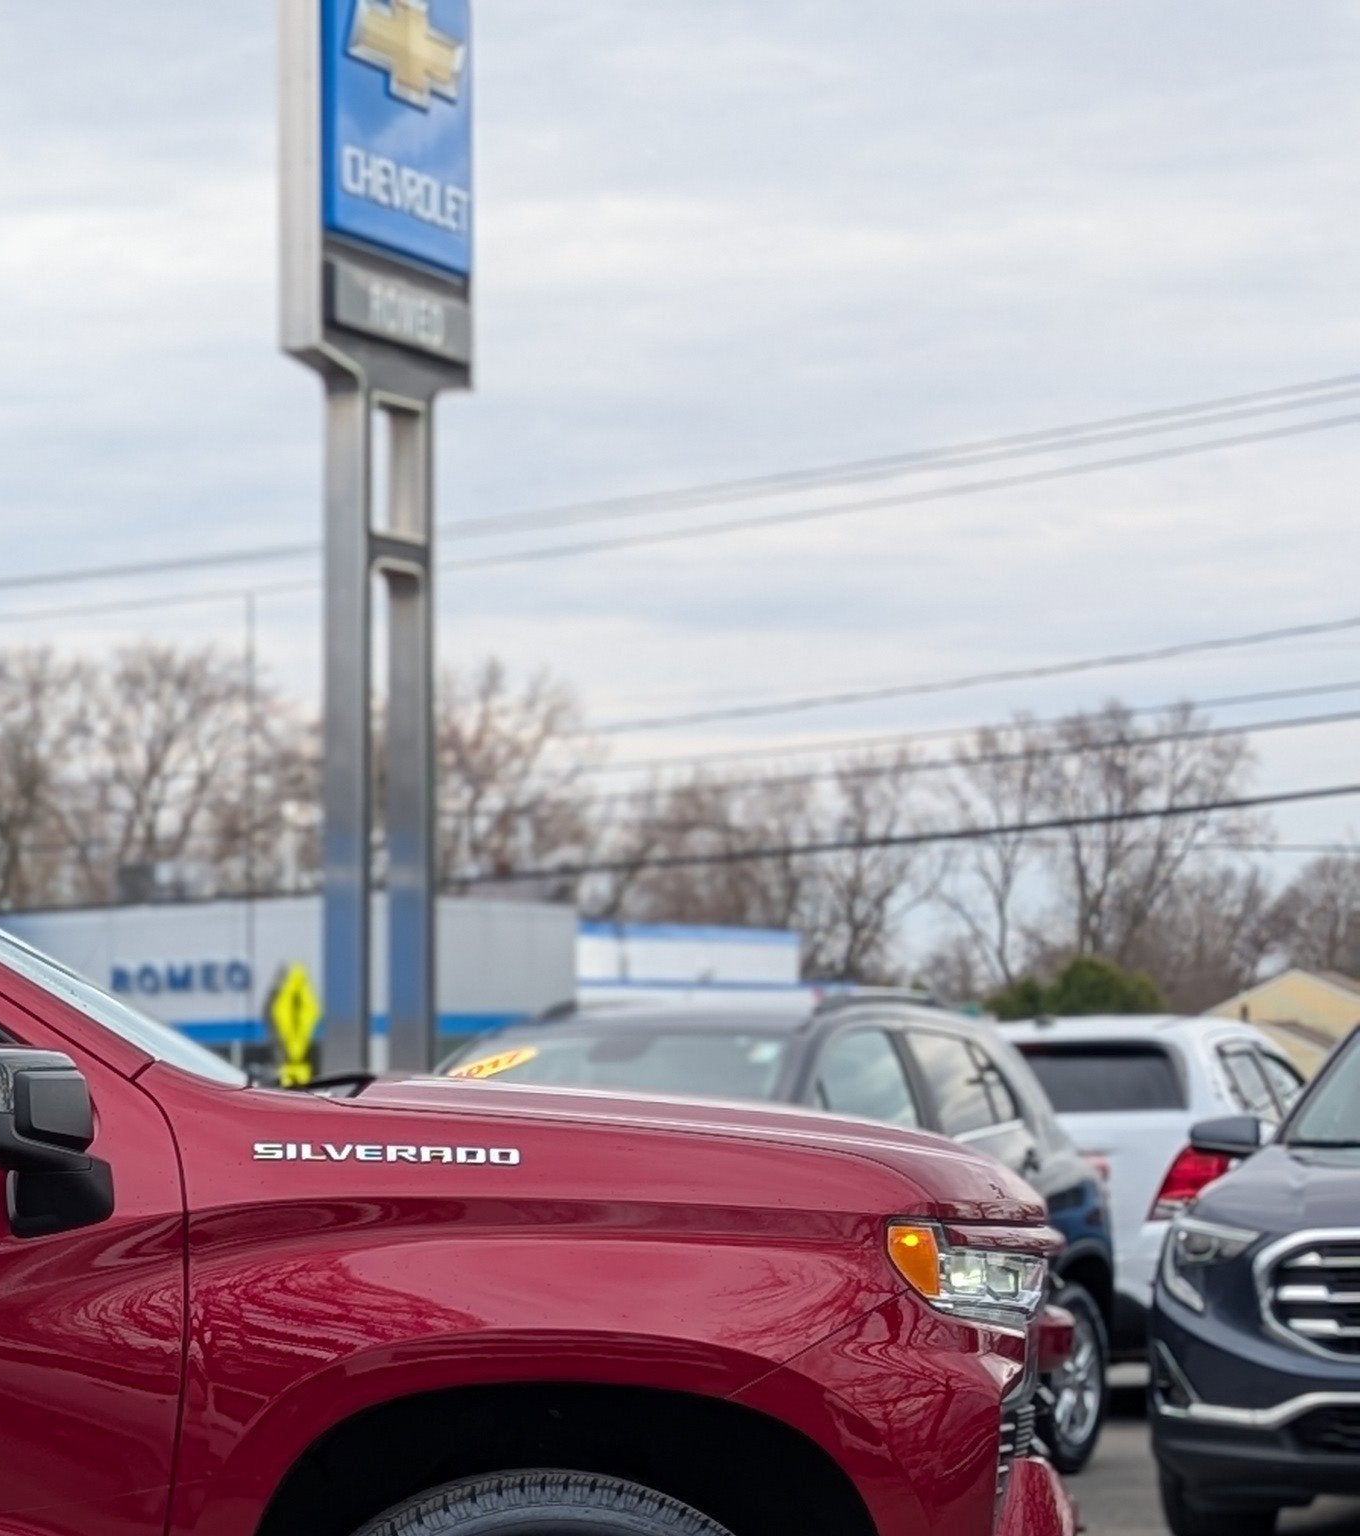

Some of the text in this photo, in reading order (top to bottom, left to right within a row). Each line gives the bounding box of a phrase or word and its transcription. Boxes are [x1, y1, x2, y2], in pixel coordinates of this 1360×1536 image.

[342, 146, 468, 230] CHEVROLET
[111, 960, 251, 994] ROMEO
[253, 1142, 522, 1166] SILVERADO
